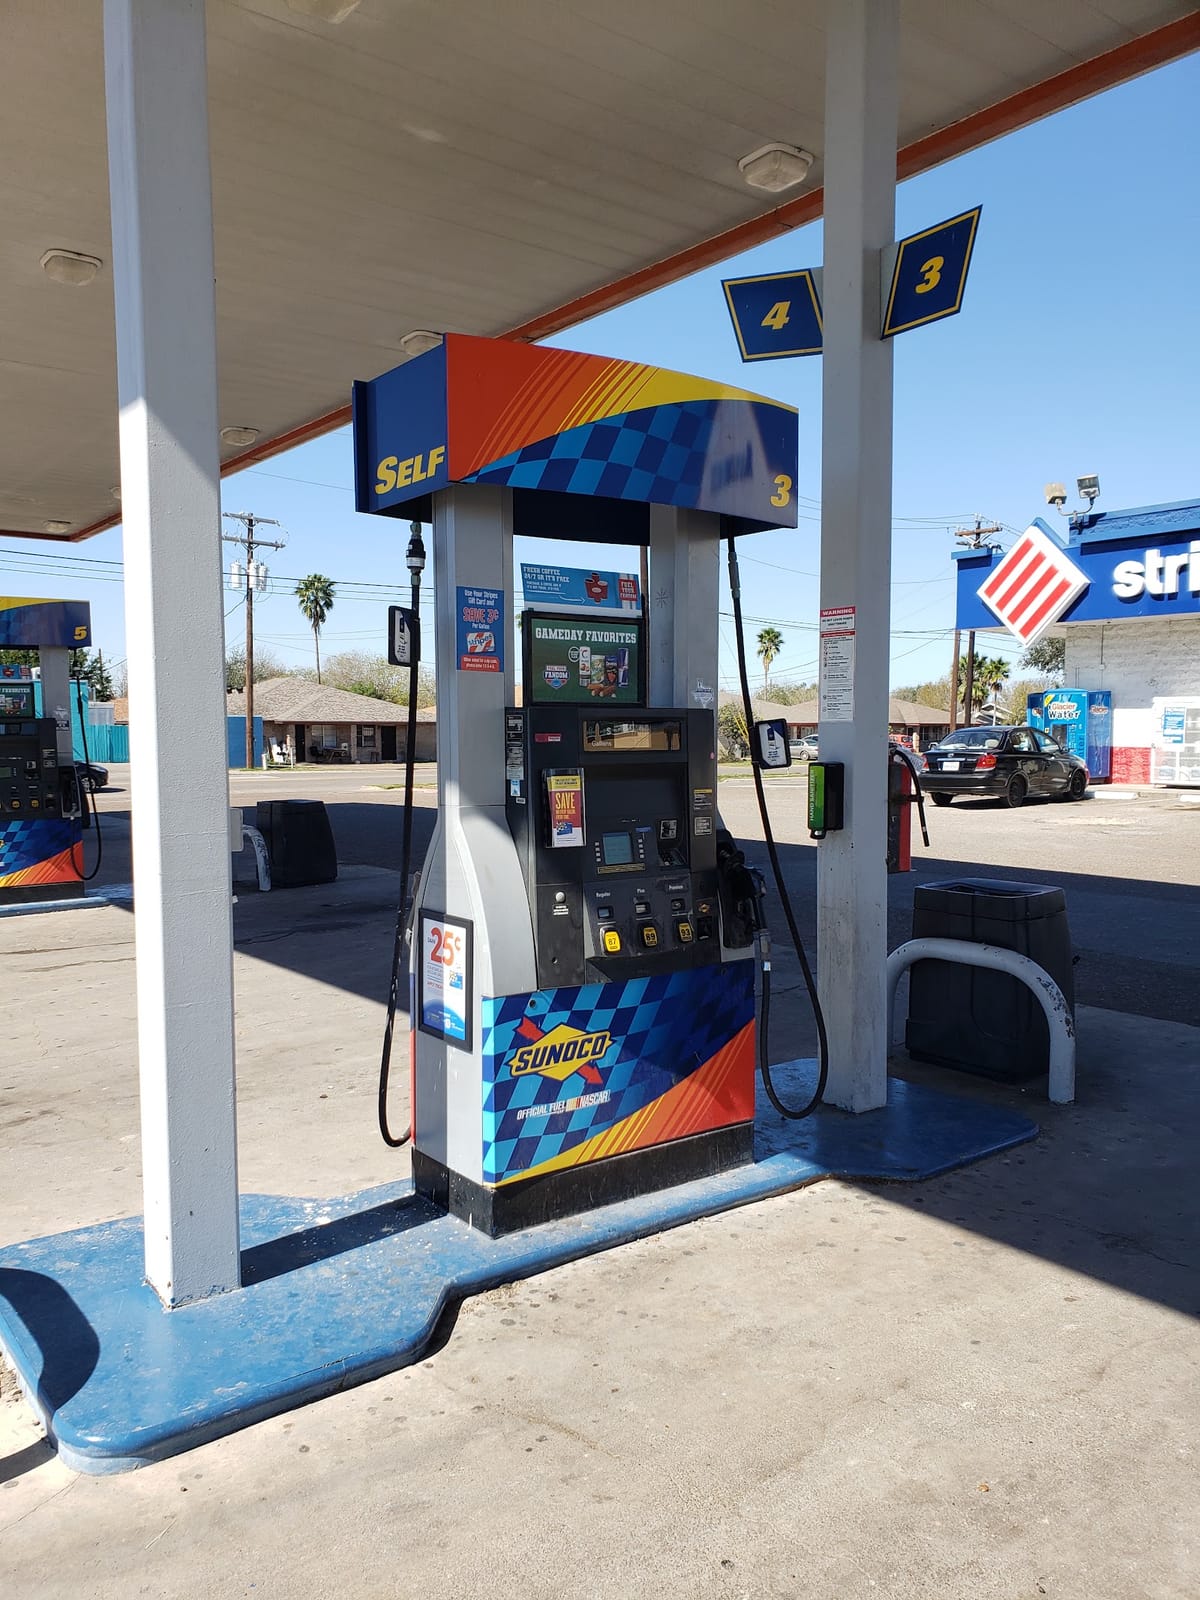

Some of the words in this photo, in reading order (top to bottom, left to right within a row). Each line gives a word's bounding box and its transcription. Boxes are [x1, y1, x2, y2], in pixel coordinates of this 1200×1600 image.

[915, 255, 945, 295] 3
[760, 300, 792, 331] 4
[374, 445, 446, 495] SELF
[769, 474, 793, 508] 3
[473, 590, 483, 598] Your
[483, 591, 498, 600] Stripes
[463, 606, 485, 623] SAVE
[822, 608, 853, 616] WARNING
[73, 626, 88, 641] 5
[535, 627, 583, 641] GAMEDAY
[585, 630, 637, 644] FAVORITES
[1048, 710, 1079, 720] Water
[1052, 702, 1077, 711] Glacier
[555, 792, 575, 809] SAVE
[645, 931, 656, 941] 89
[680, 926, 691, 937] 93
[608, 937, 617, 946] 87
[515, 1034, 608, 1073] SUNOCO
[516, 1103, 548, 1120] OFFICIAL
[548, 1101, 568, 1113] FUEL
[580, 1090, 611, 1109] NASCAR
